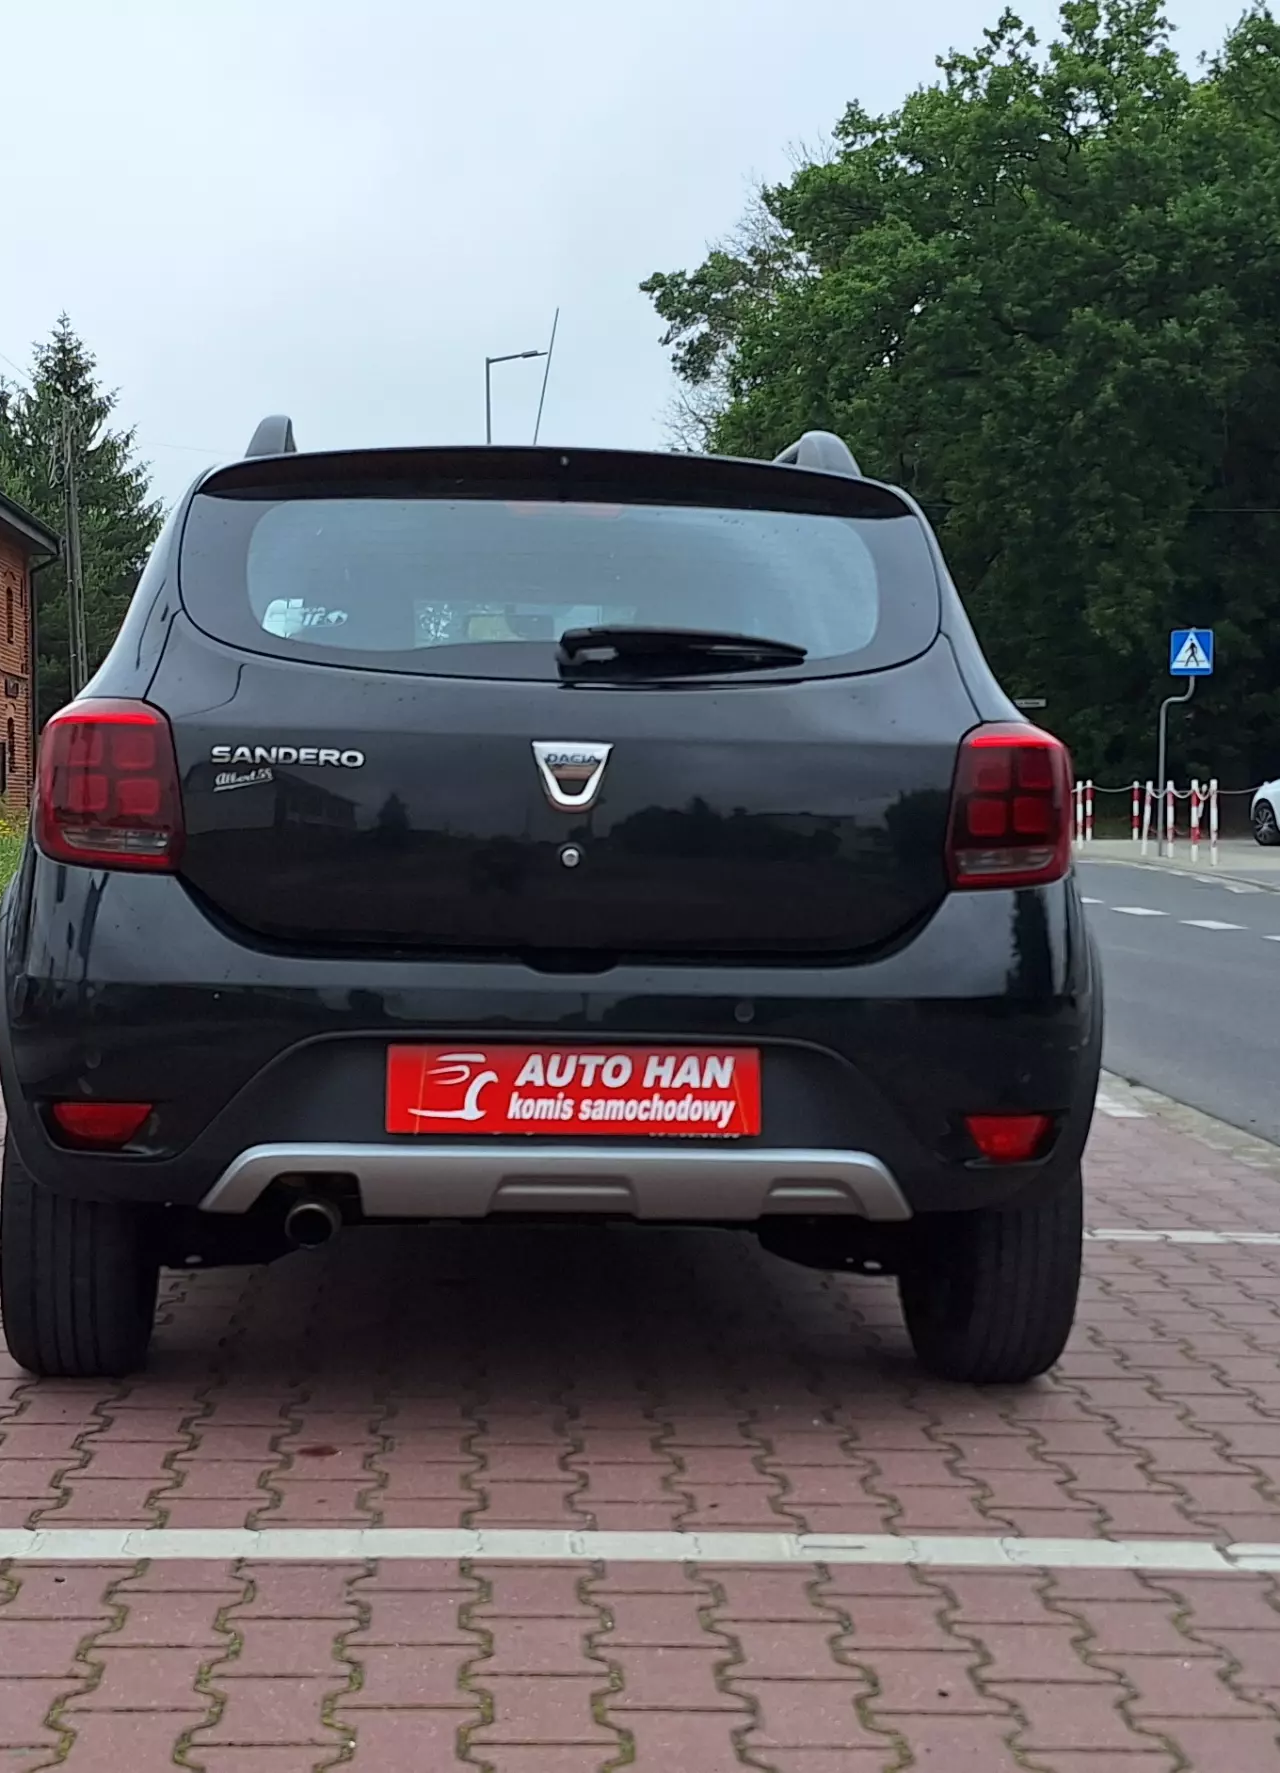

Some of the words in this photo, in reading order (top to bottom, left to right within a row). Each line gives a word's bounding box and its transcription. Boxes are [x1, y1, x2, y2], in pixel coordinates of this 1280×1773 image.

[211, 746, 365, 767] SANDERO
[545, 753, 600, 764] DACIA
[514, 1053, 633, 1089] AUTO
[642, 1055, 736, 1090] HAN
[507, 1092, 574, 1121] komis
[578, 1093, 736, 1129] samochodowy
